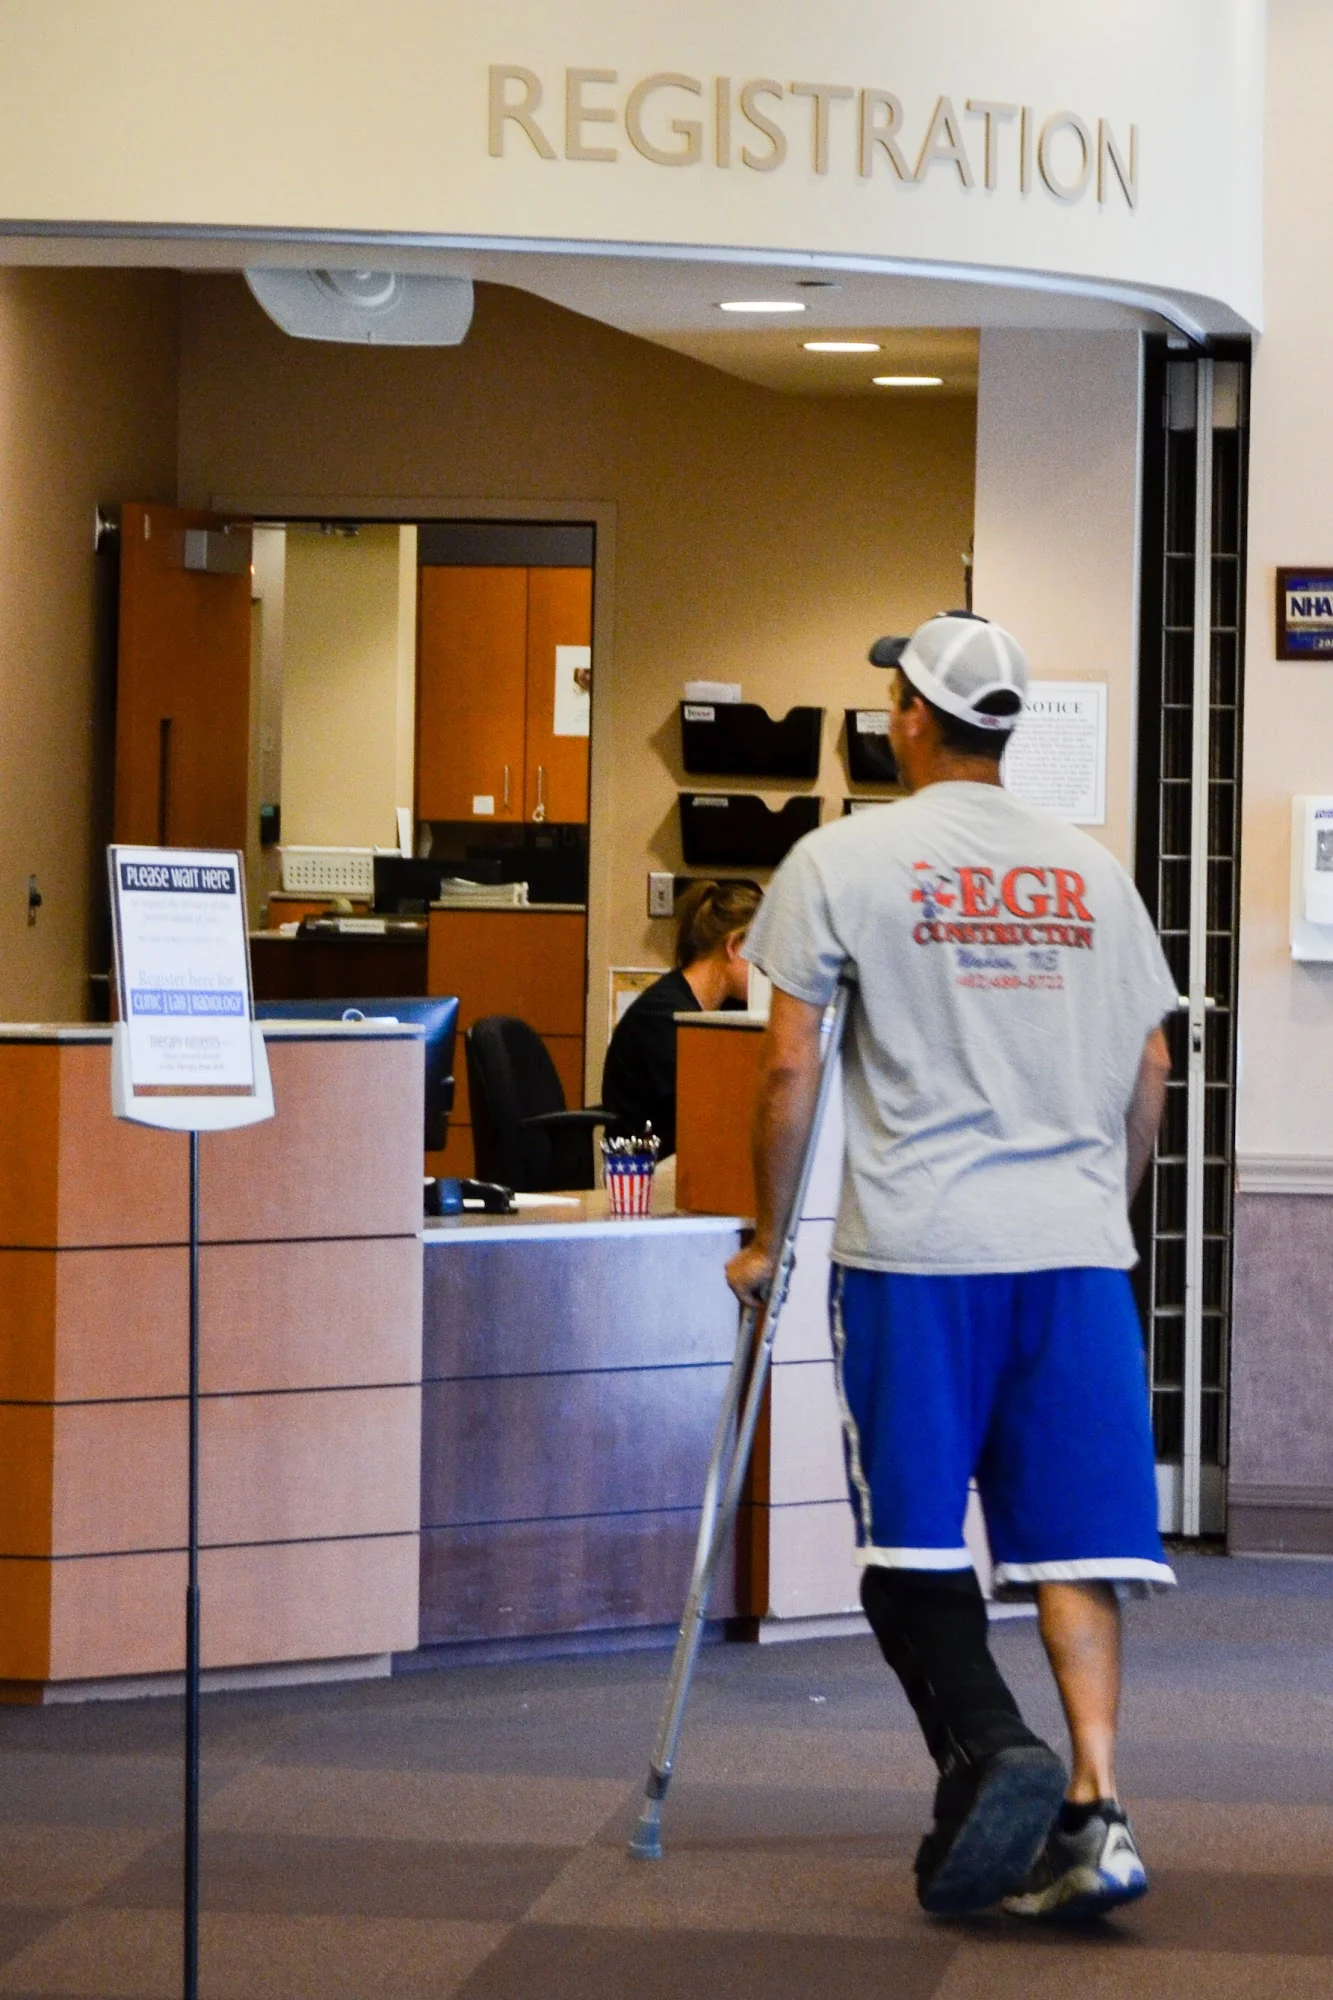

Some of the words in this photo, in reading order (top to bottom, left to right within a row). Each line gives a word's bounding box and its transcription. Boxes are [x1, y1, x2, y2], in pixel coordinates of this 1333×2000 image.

[487, 63, 1140, 210] REGISTRATION
[1022, 701, 1084, 714] NOTICE
[952, 866, 1096, 922] EGR
[912, 921, 1095, 949] CONSTRUCTION
